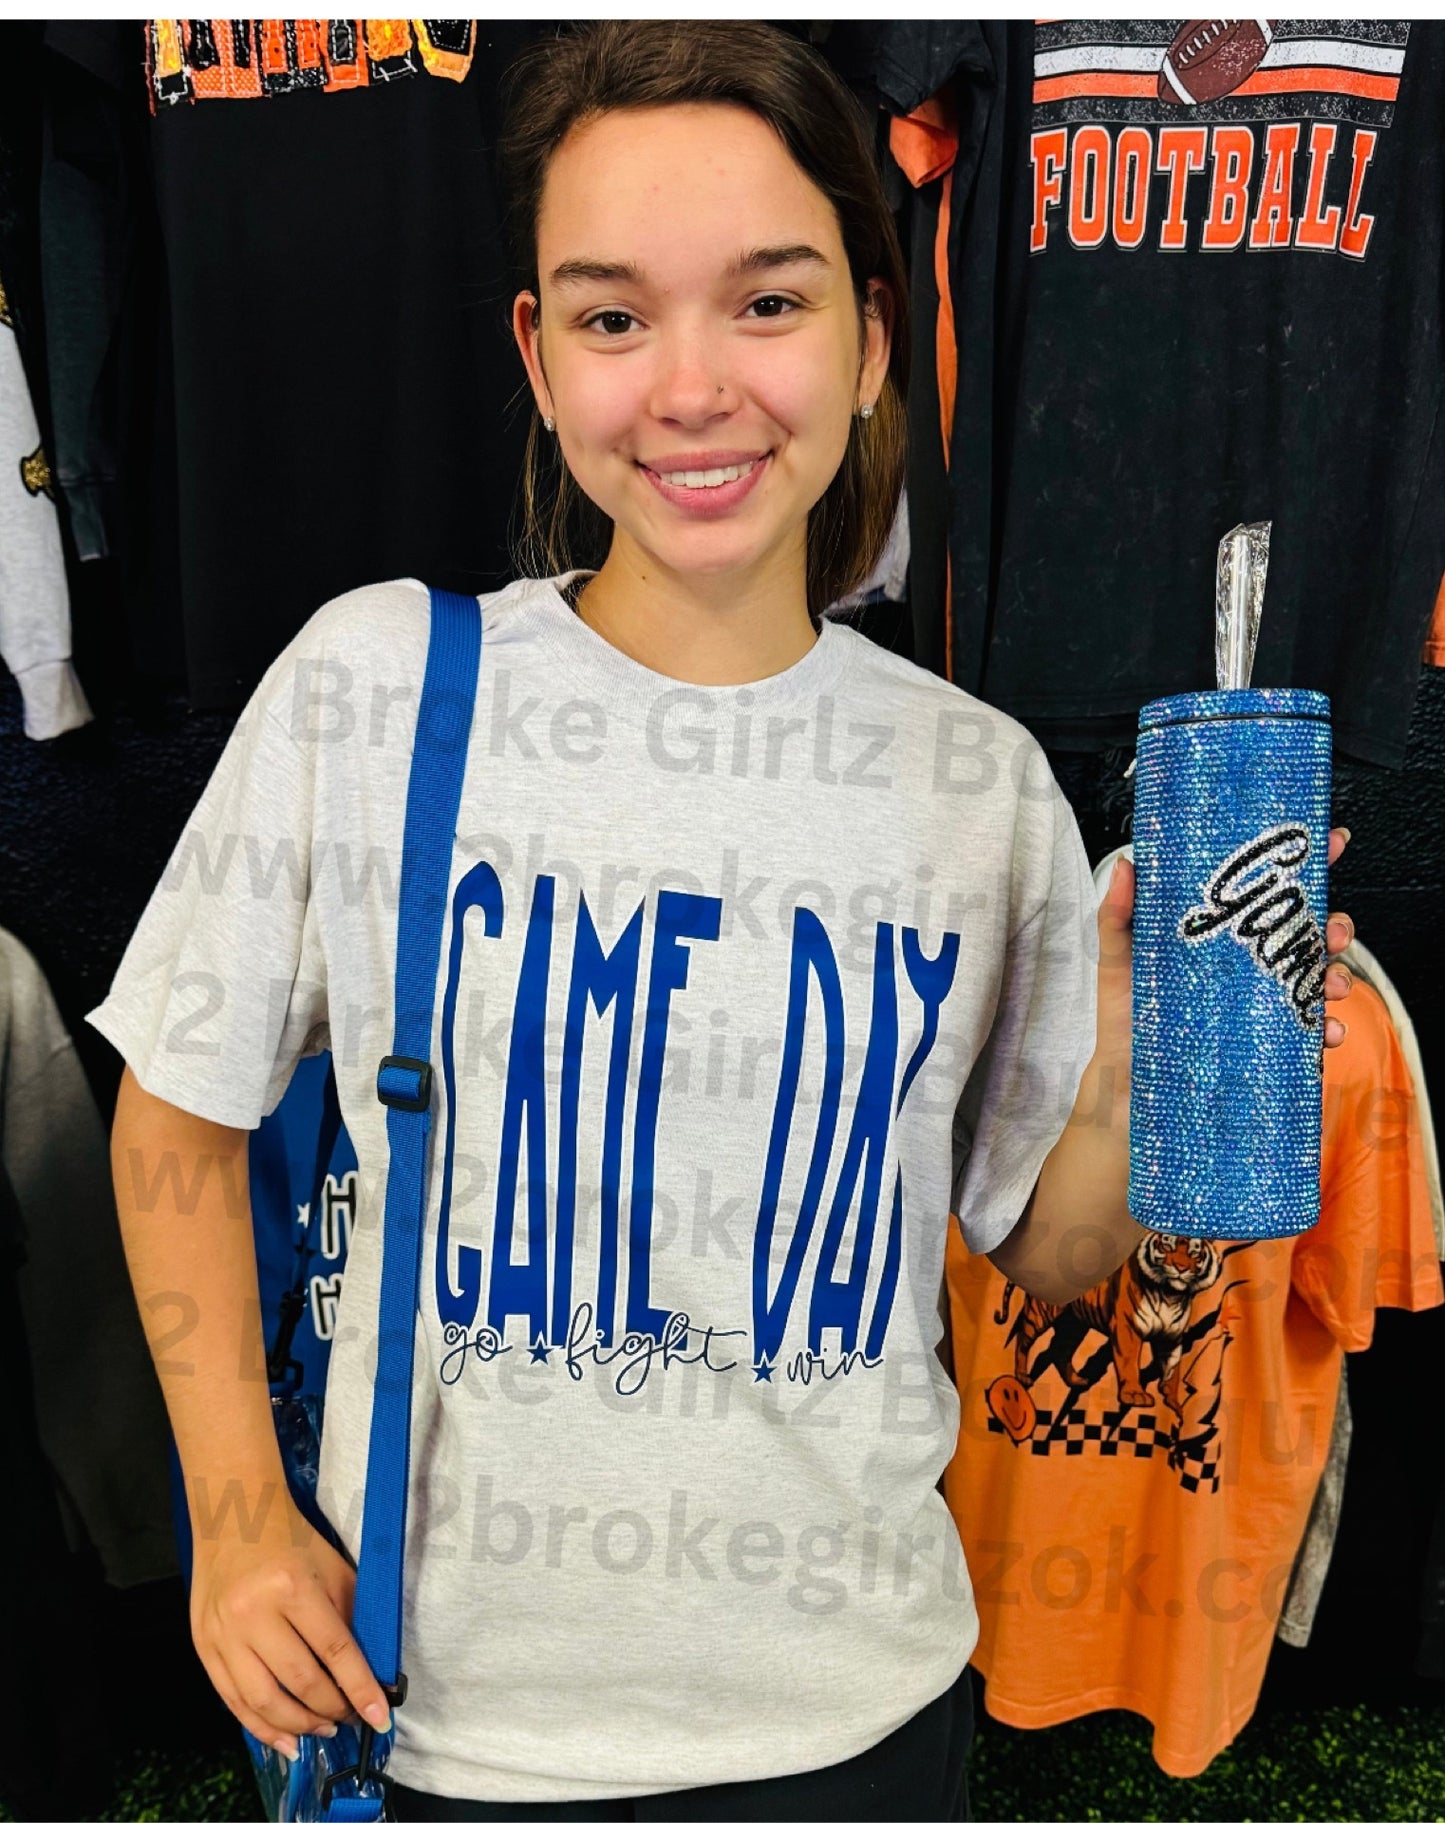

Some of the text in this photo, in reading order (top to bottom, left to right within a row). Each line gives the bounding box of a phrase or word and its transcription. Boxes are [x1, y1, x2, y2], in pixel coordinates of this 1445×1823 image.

[1029, 124, 1379, 260] FOOTBALL
[438, 860, 961, 1356] GAME DAY
[440, 1302, 884, 1396] go fight win
